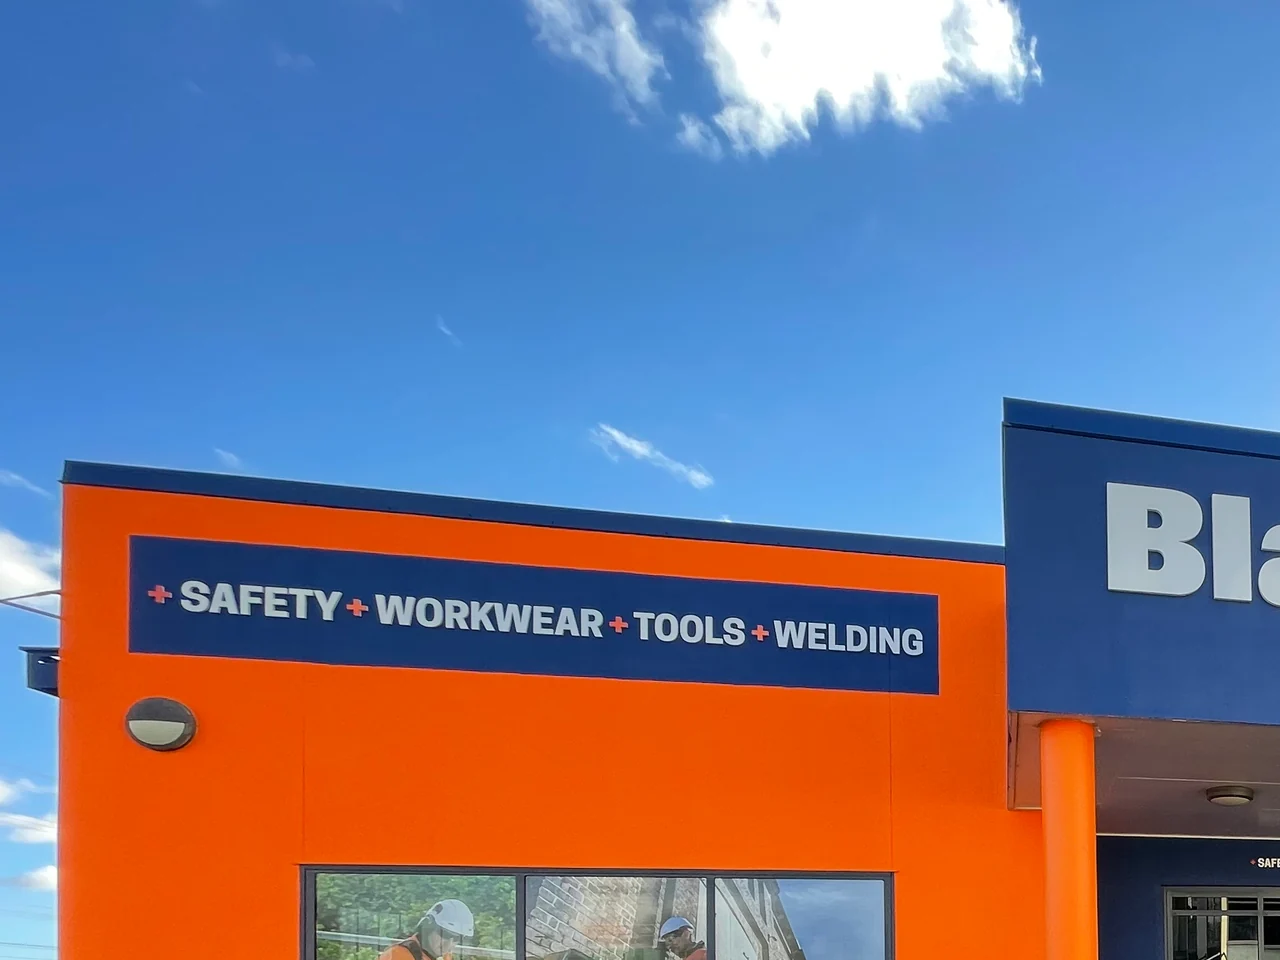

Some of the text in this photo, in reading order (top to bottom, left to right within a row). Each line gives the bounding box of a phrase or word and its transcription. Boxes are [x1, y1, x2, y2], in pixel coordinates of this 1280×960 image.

[179, 579, 924, 657] SAFETY WORKWEAR TOOLS WELDING
